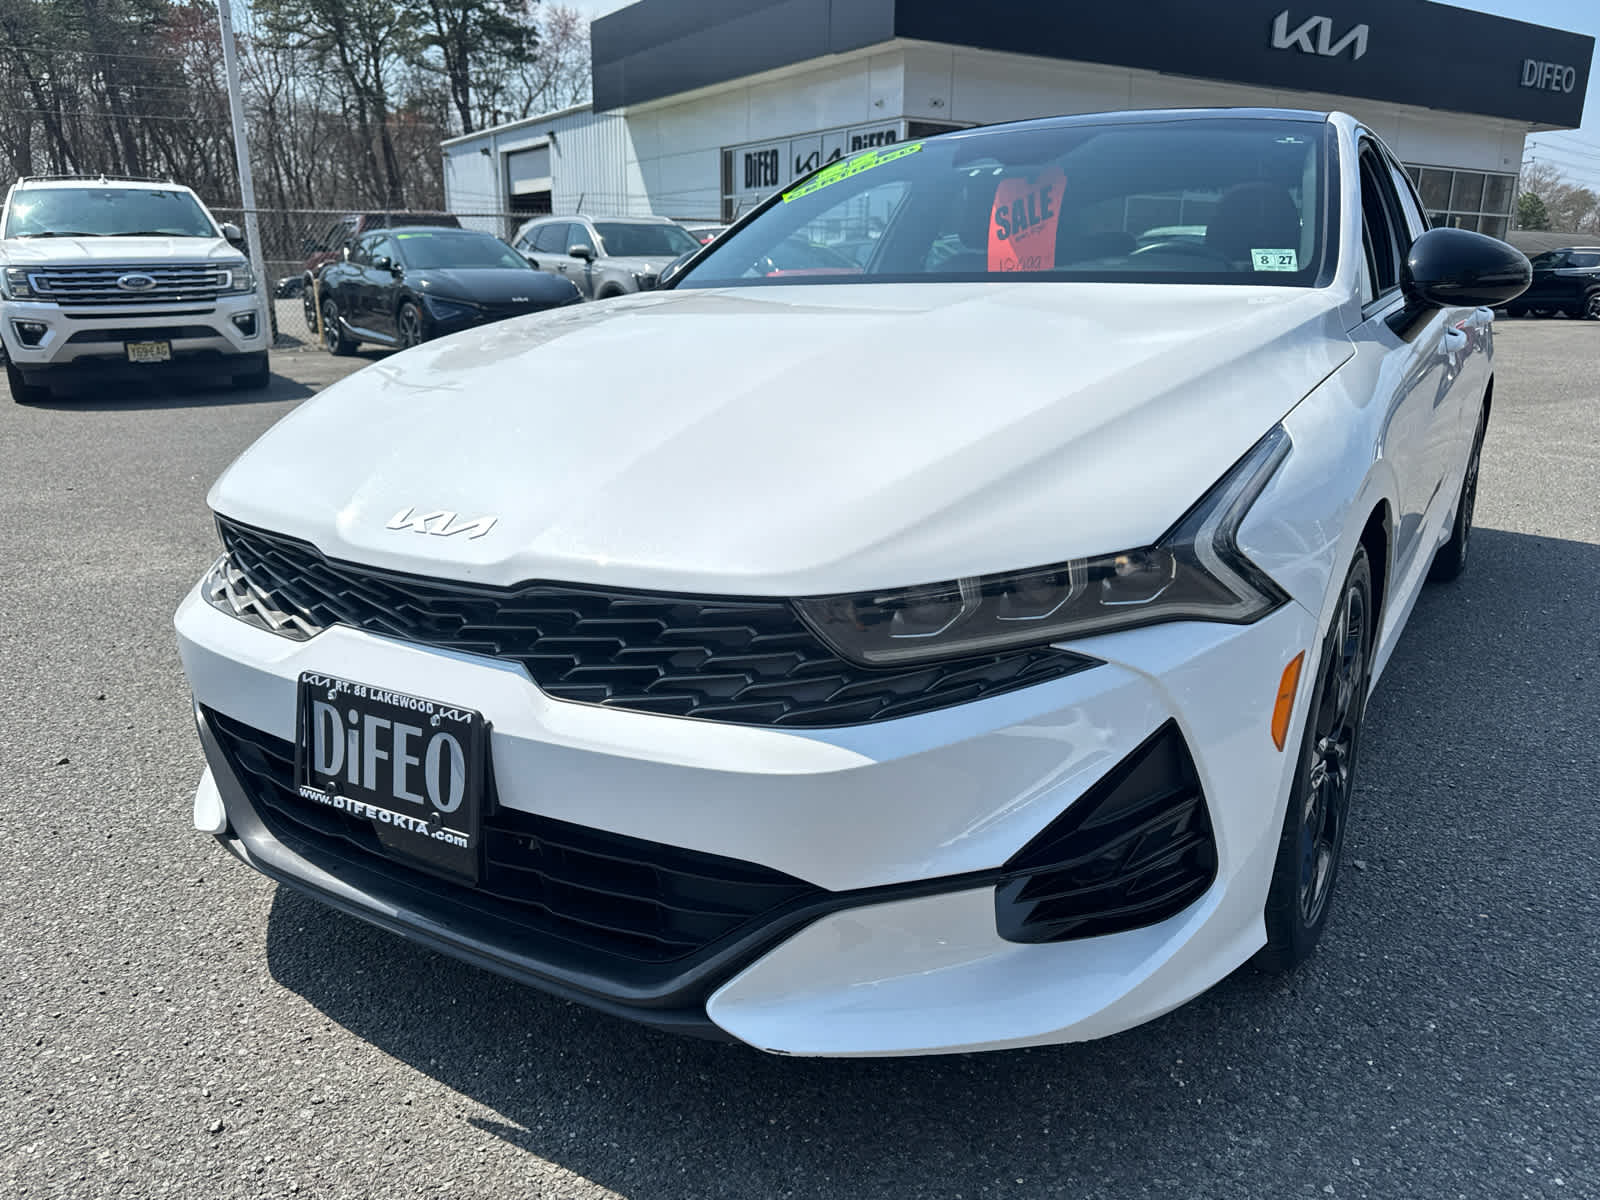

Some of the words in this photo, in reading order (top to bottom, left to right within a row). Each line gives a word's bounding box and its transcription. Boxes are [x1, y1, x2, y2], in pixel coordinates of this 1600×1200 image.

[1272, 10, 1369, 60] KIA
[1522, 58, 1576, 94] DIFEO
[995, 184, 1054, 240] SALE
[1260, 255, 1270, 265] 8
[1278, 255, 1293, 265] 27
[386, 507, 498, 540] KIA
[302, 673, 330, 688] KIA
[335, 680, 351, 694] RT.
[354, 686, 367, 698] 88
[370, 689, 434, 714] LAKEWOOD
[439, 707, 472, 724] KIA
[313, 700, 466, 814] DiFEO
